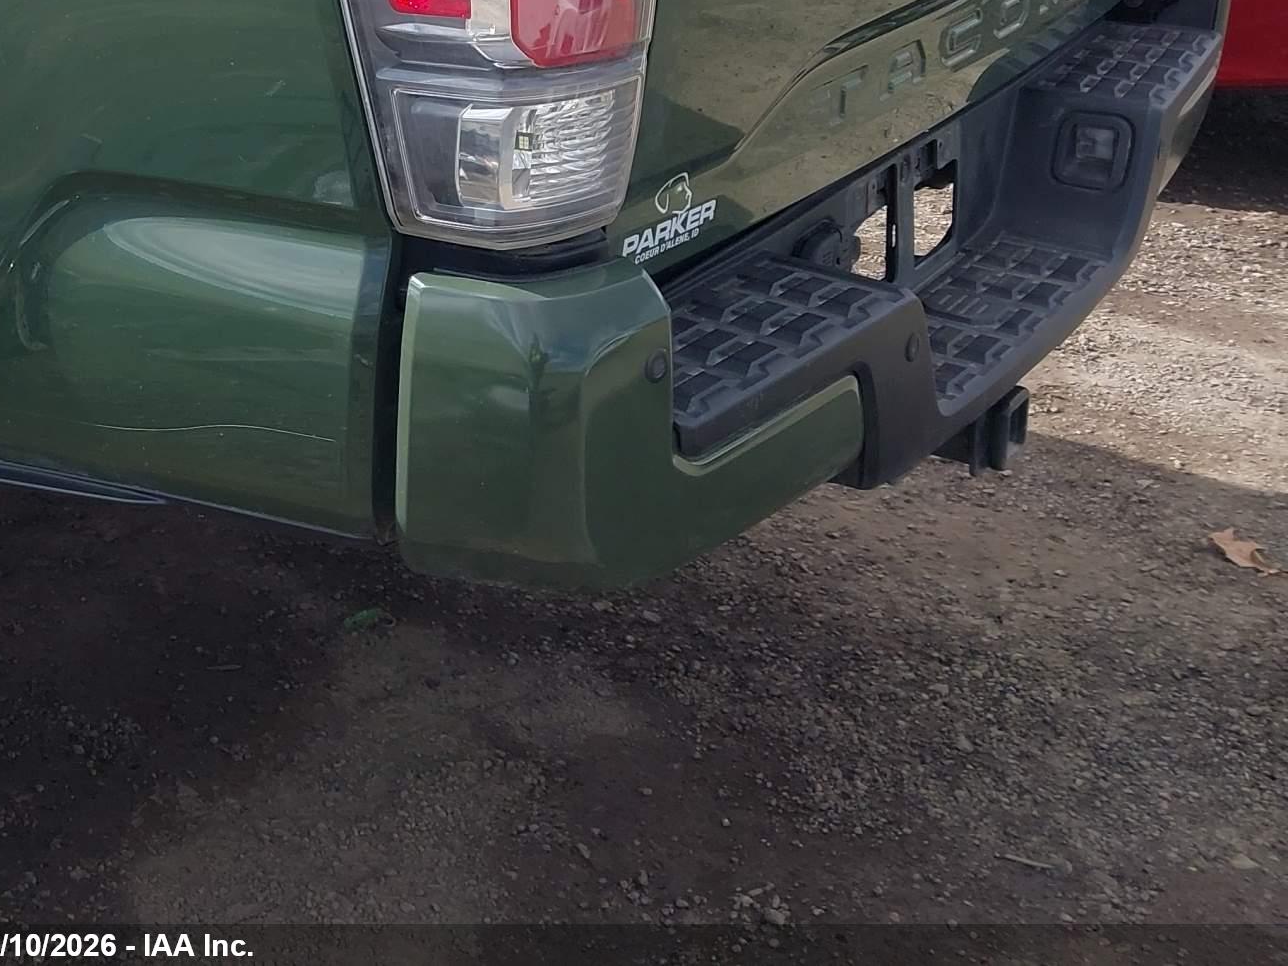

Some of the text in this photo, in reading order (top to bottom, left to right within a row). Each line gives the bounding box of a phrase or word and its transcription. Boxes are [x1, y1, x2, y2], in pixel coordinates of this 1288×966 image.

[621, 199, 718, 258] PARKER
[634, 244, 661, 265] COEUR
[690, 227, 700, 240] ID
